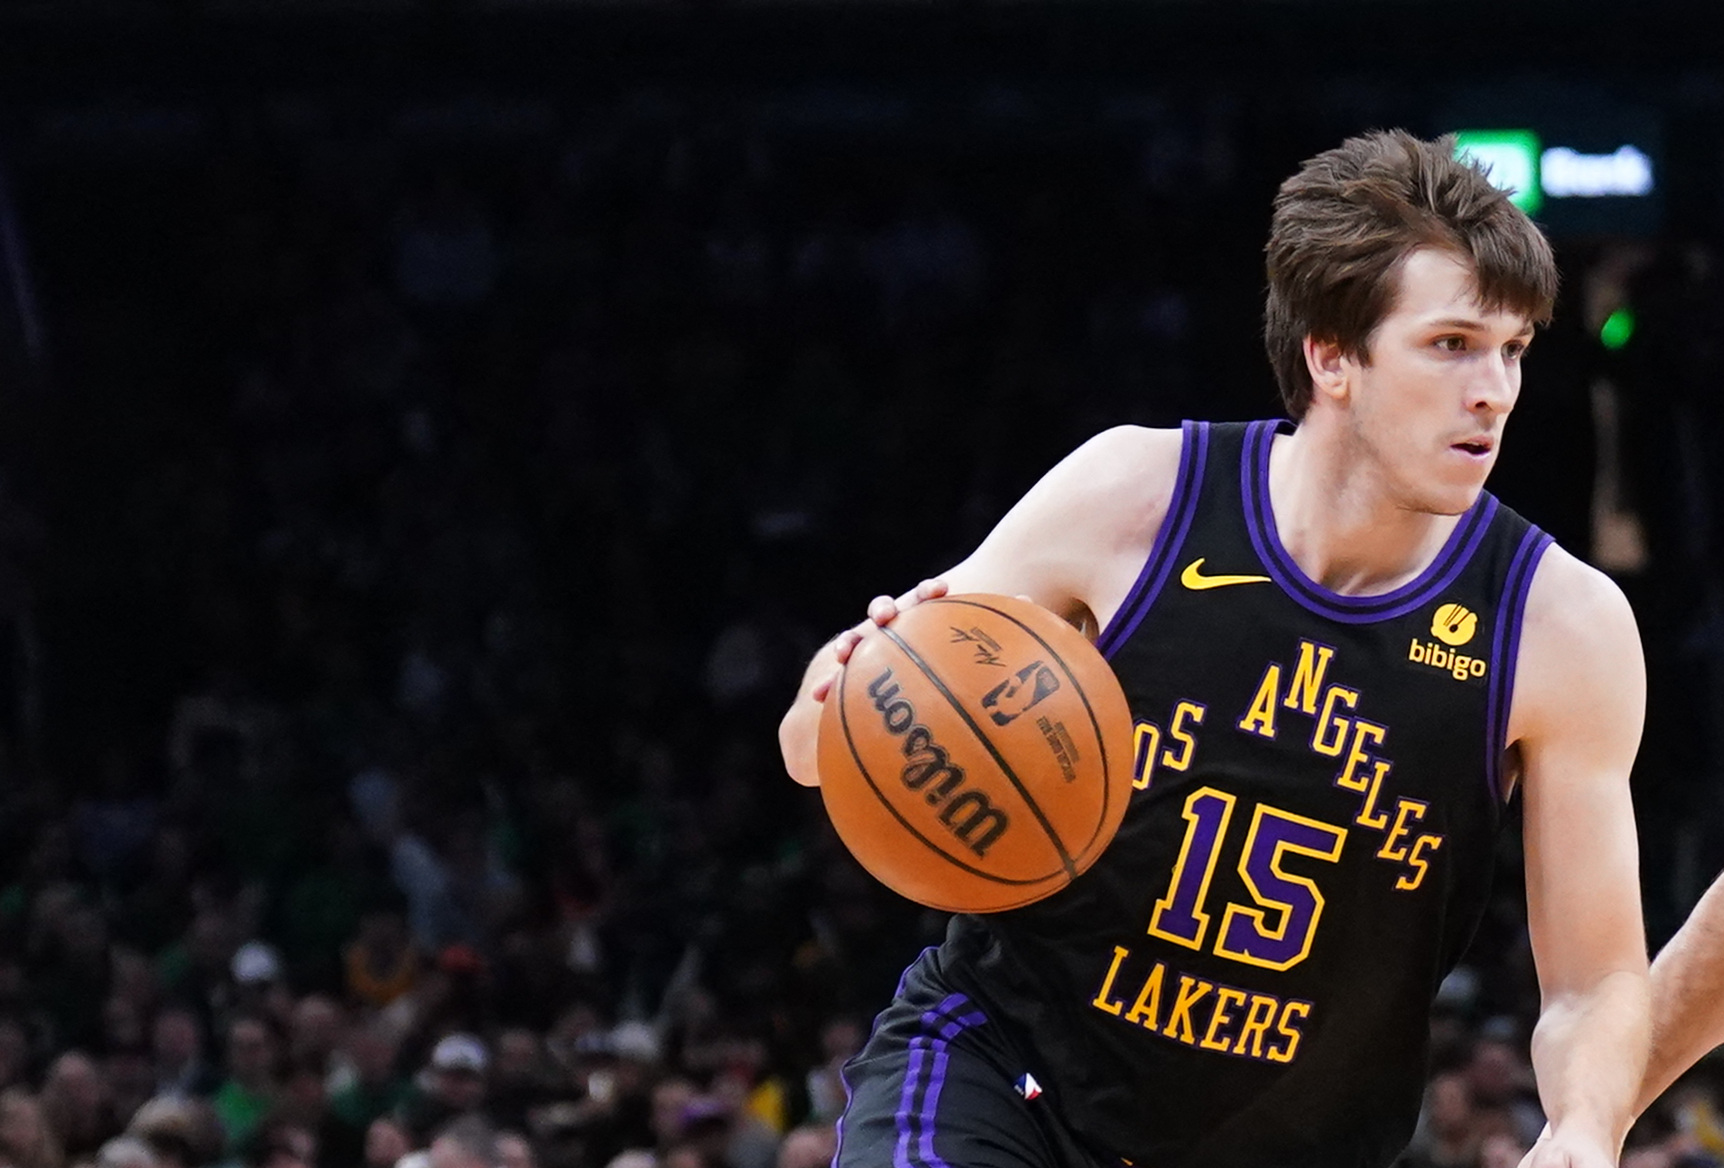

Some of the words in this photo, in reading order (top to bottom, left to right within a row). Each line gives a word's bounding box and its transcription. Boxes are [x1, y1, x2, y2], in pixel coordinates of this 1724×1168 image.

[1408, 638, 1487, 681] bibigo
[867, 667, 1009, 861] Wilson
[1131, 699, 1207, 791] OS
[1236, 638, 1445, 892] ANGELES
[1147, 786, 1348, 972] 15
[1092, 945, 1313, 1064] LAKERS
